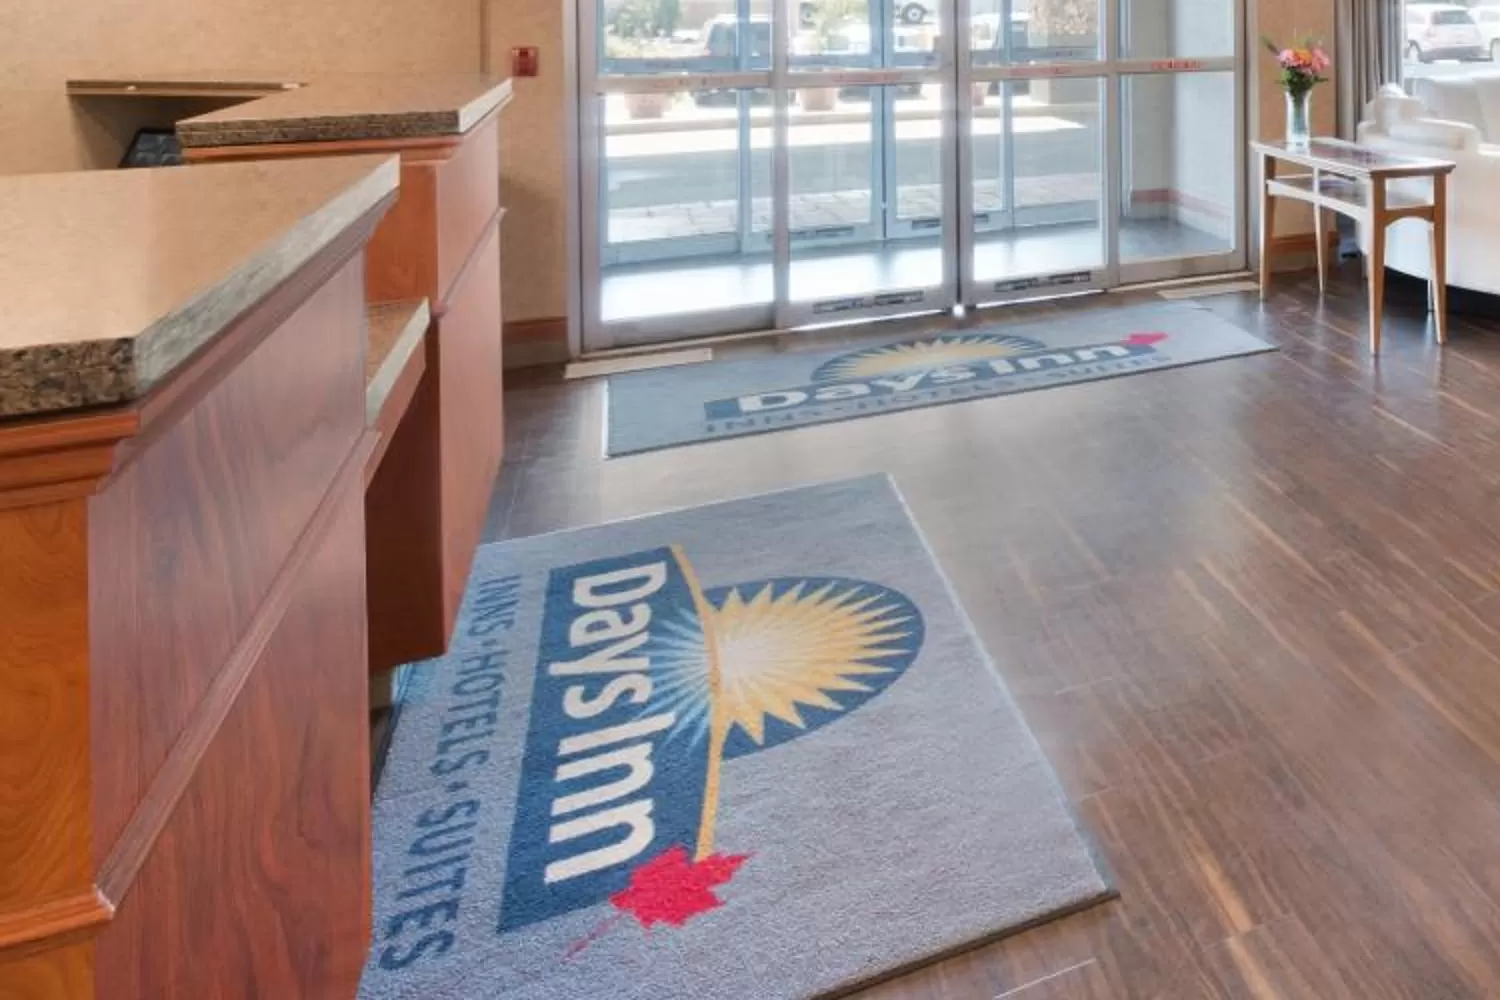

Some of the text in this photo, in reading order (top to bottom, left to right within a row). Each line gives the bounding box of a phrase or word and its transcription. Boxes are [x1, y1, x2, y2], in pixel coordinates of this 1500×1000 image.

[738, 344, 1132, 413] Days Inn
[378, 574, 522, 971] INNS HOTELS SUITES
[543, 561, 676, 885] Days Inn
